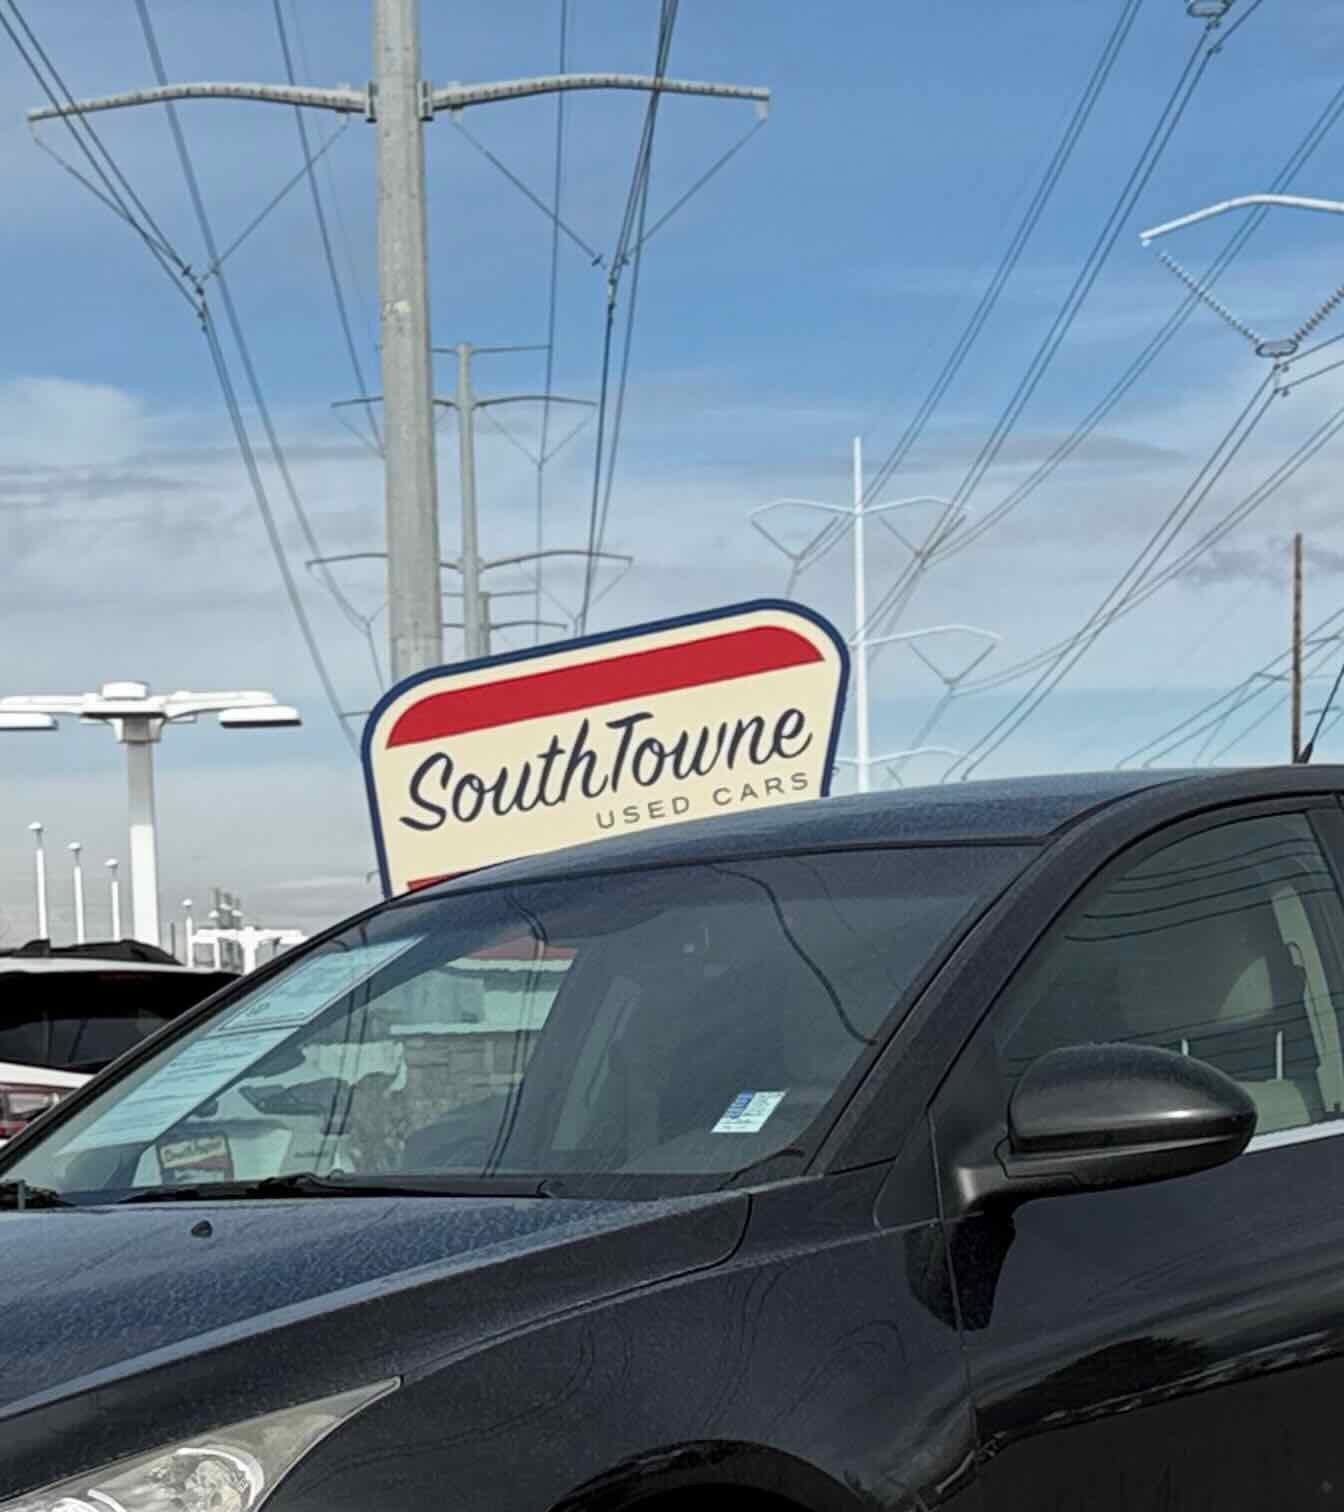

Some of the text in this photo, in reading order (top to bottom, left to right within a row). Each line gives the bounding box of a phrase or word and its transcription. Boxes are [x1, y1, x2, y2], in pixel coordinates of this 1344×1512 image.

[399, 708, 813, 832] SouthTowne
[595, 771, 809, 830] USED CARS
